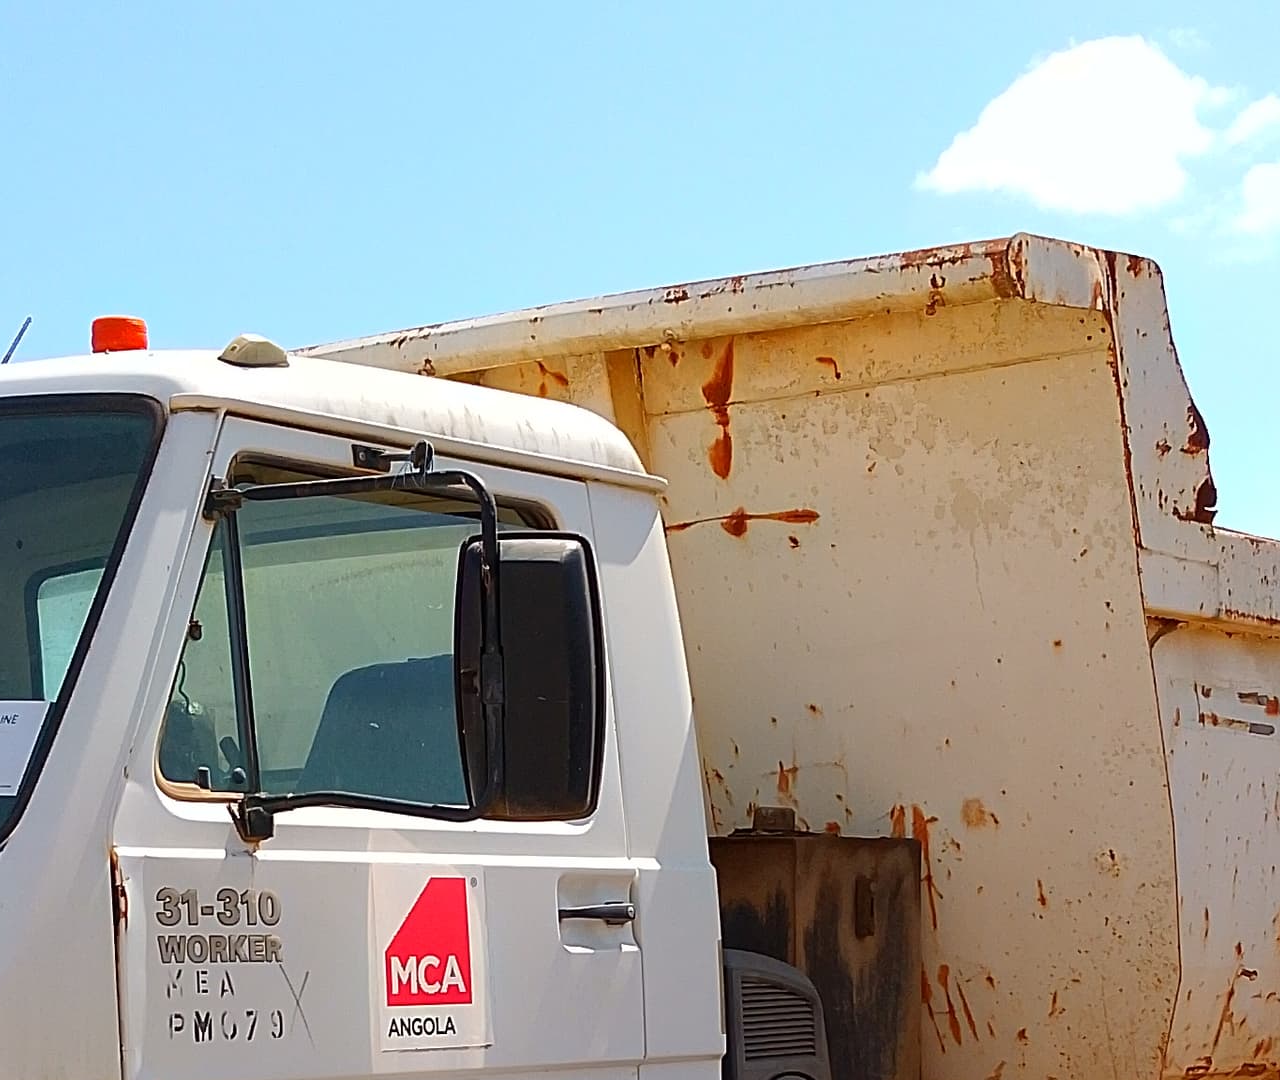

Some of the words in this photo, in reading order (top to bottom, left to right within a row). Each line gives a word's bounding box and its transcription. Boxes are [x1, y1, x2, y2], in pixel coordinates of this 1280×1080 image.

[156, 887, 282, 927] 31-310
[157, 934, 284, 964] WORKER
[390, 955, 467, 995] MCA
[388, 1016, 457, 1038] ANGOLA
